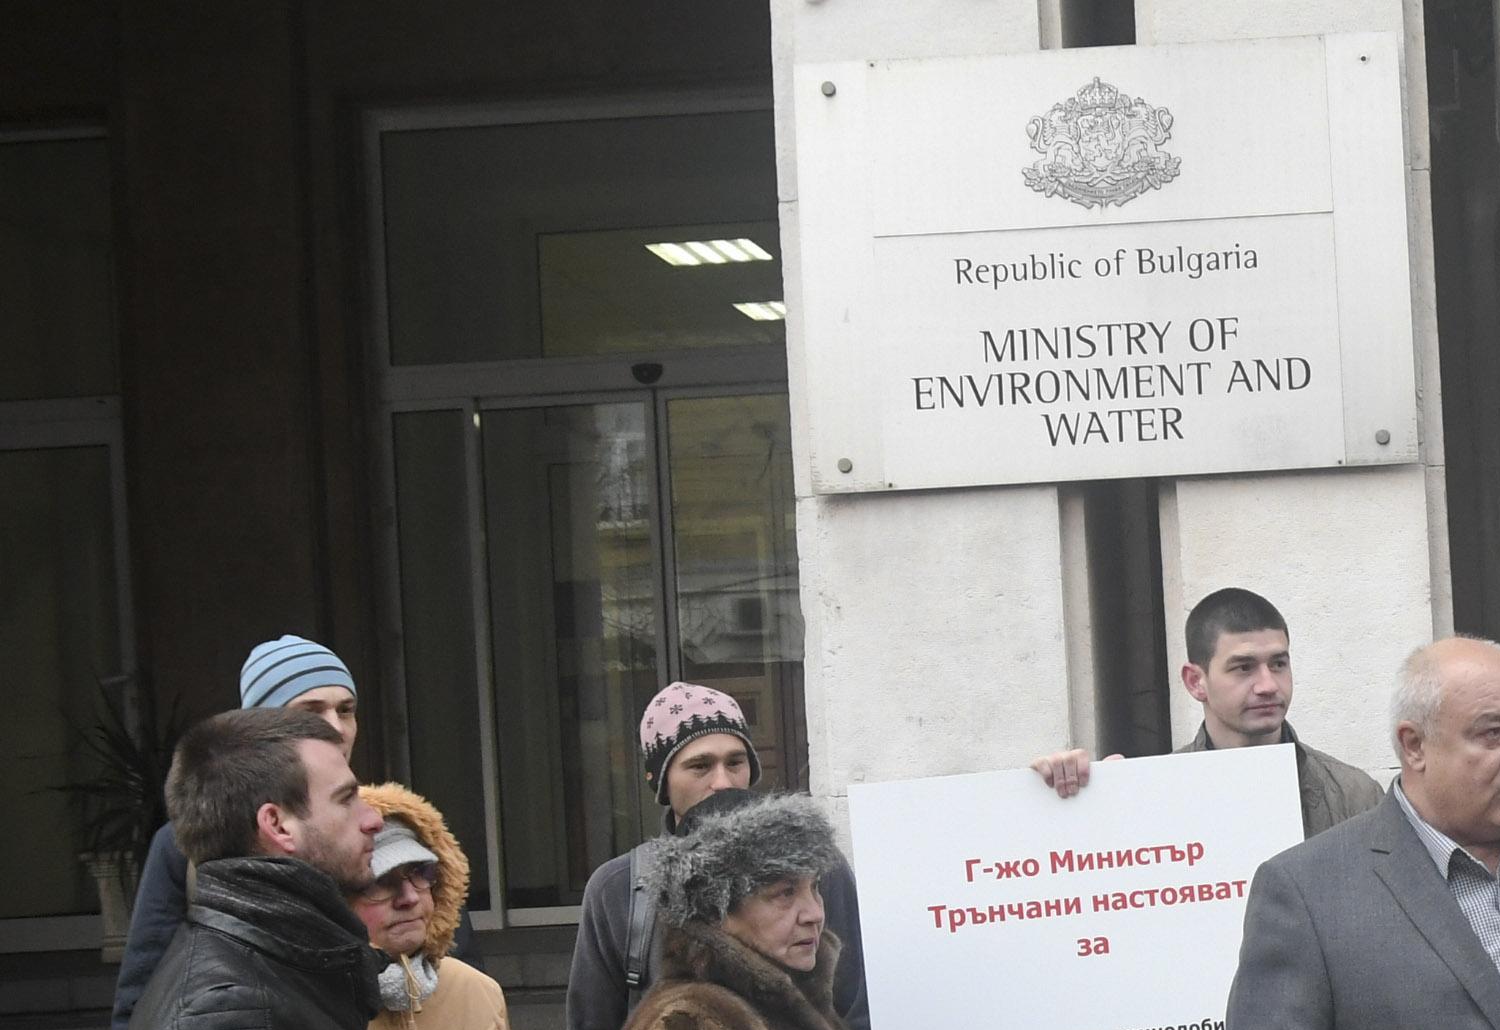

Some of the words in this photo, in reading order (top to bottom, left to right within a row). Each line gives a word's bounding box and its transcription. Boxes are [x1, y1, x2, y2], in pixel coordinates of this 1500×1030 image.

[954, 252, 1084, 292] Republic
[1093, 248, 1128, 279] of
[1134, 242, 1259, 281] Bulgaria
[979, 320, 1172, 364] MINISTRY
[1188, 316, 1239, 353] OF
[911, 361, 1212, 411] ENVIRONMENT
[1226, 356, 1312, 394] AND
[1040, 406, 1184, 448] WATER
[964, 857, 1041, 883] Г-жо
[1049, 841, 1205, 875] Министър
[926, 896, 1083, 934] Трънчани
[1091, 879, 1248, 913] настояват
[1076, 936, 1110, 958] за
